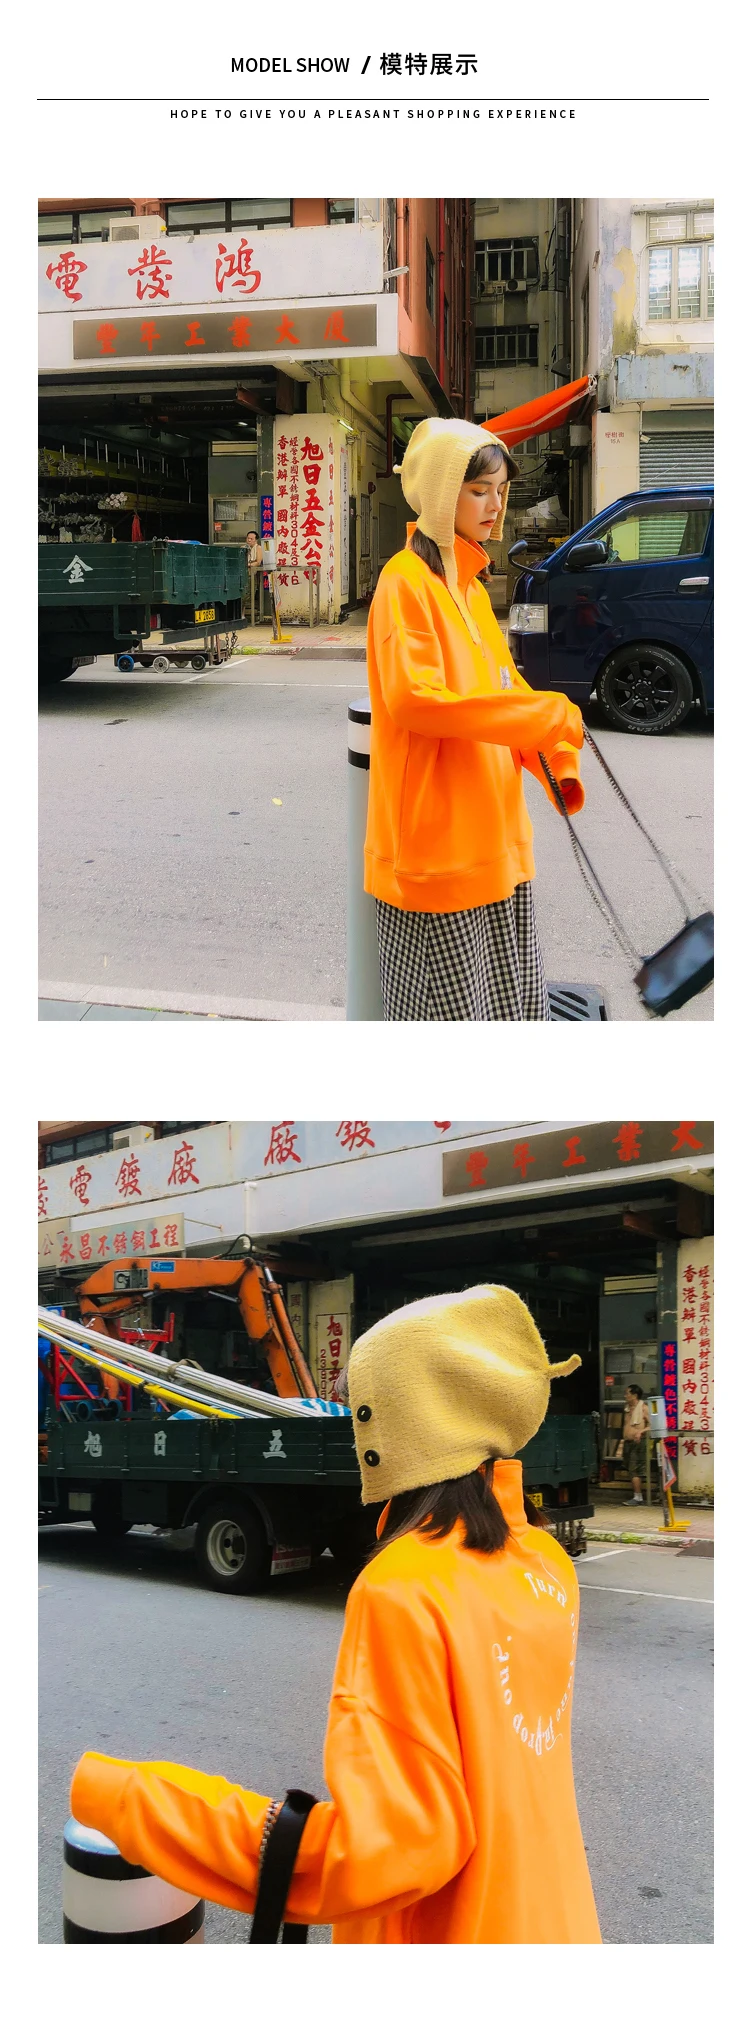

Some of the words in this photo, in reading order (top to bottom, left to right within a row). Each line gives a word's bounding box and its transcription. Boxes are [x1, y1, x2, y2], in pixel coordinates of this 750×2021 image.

[96, 310, 350, 354] 豐年工業大廈
[62, 554, 94, 584] 金
